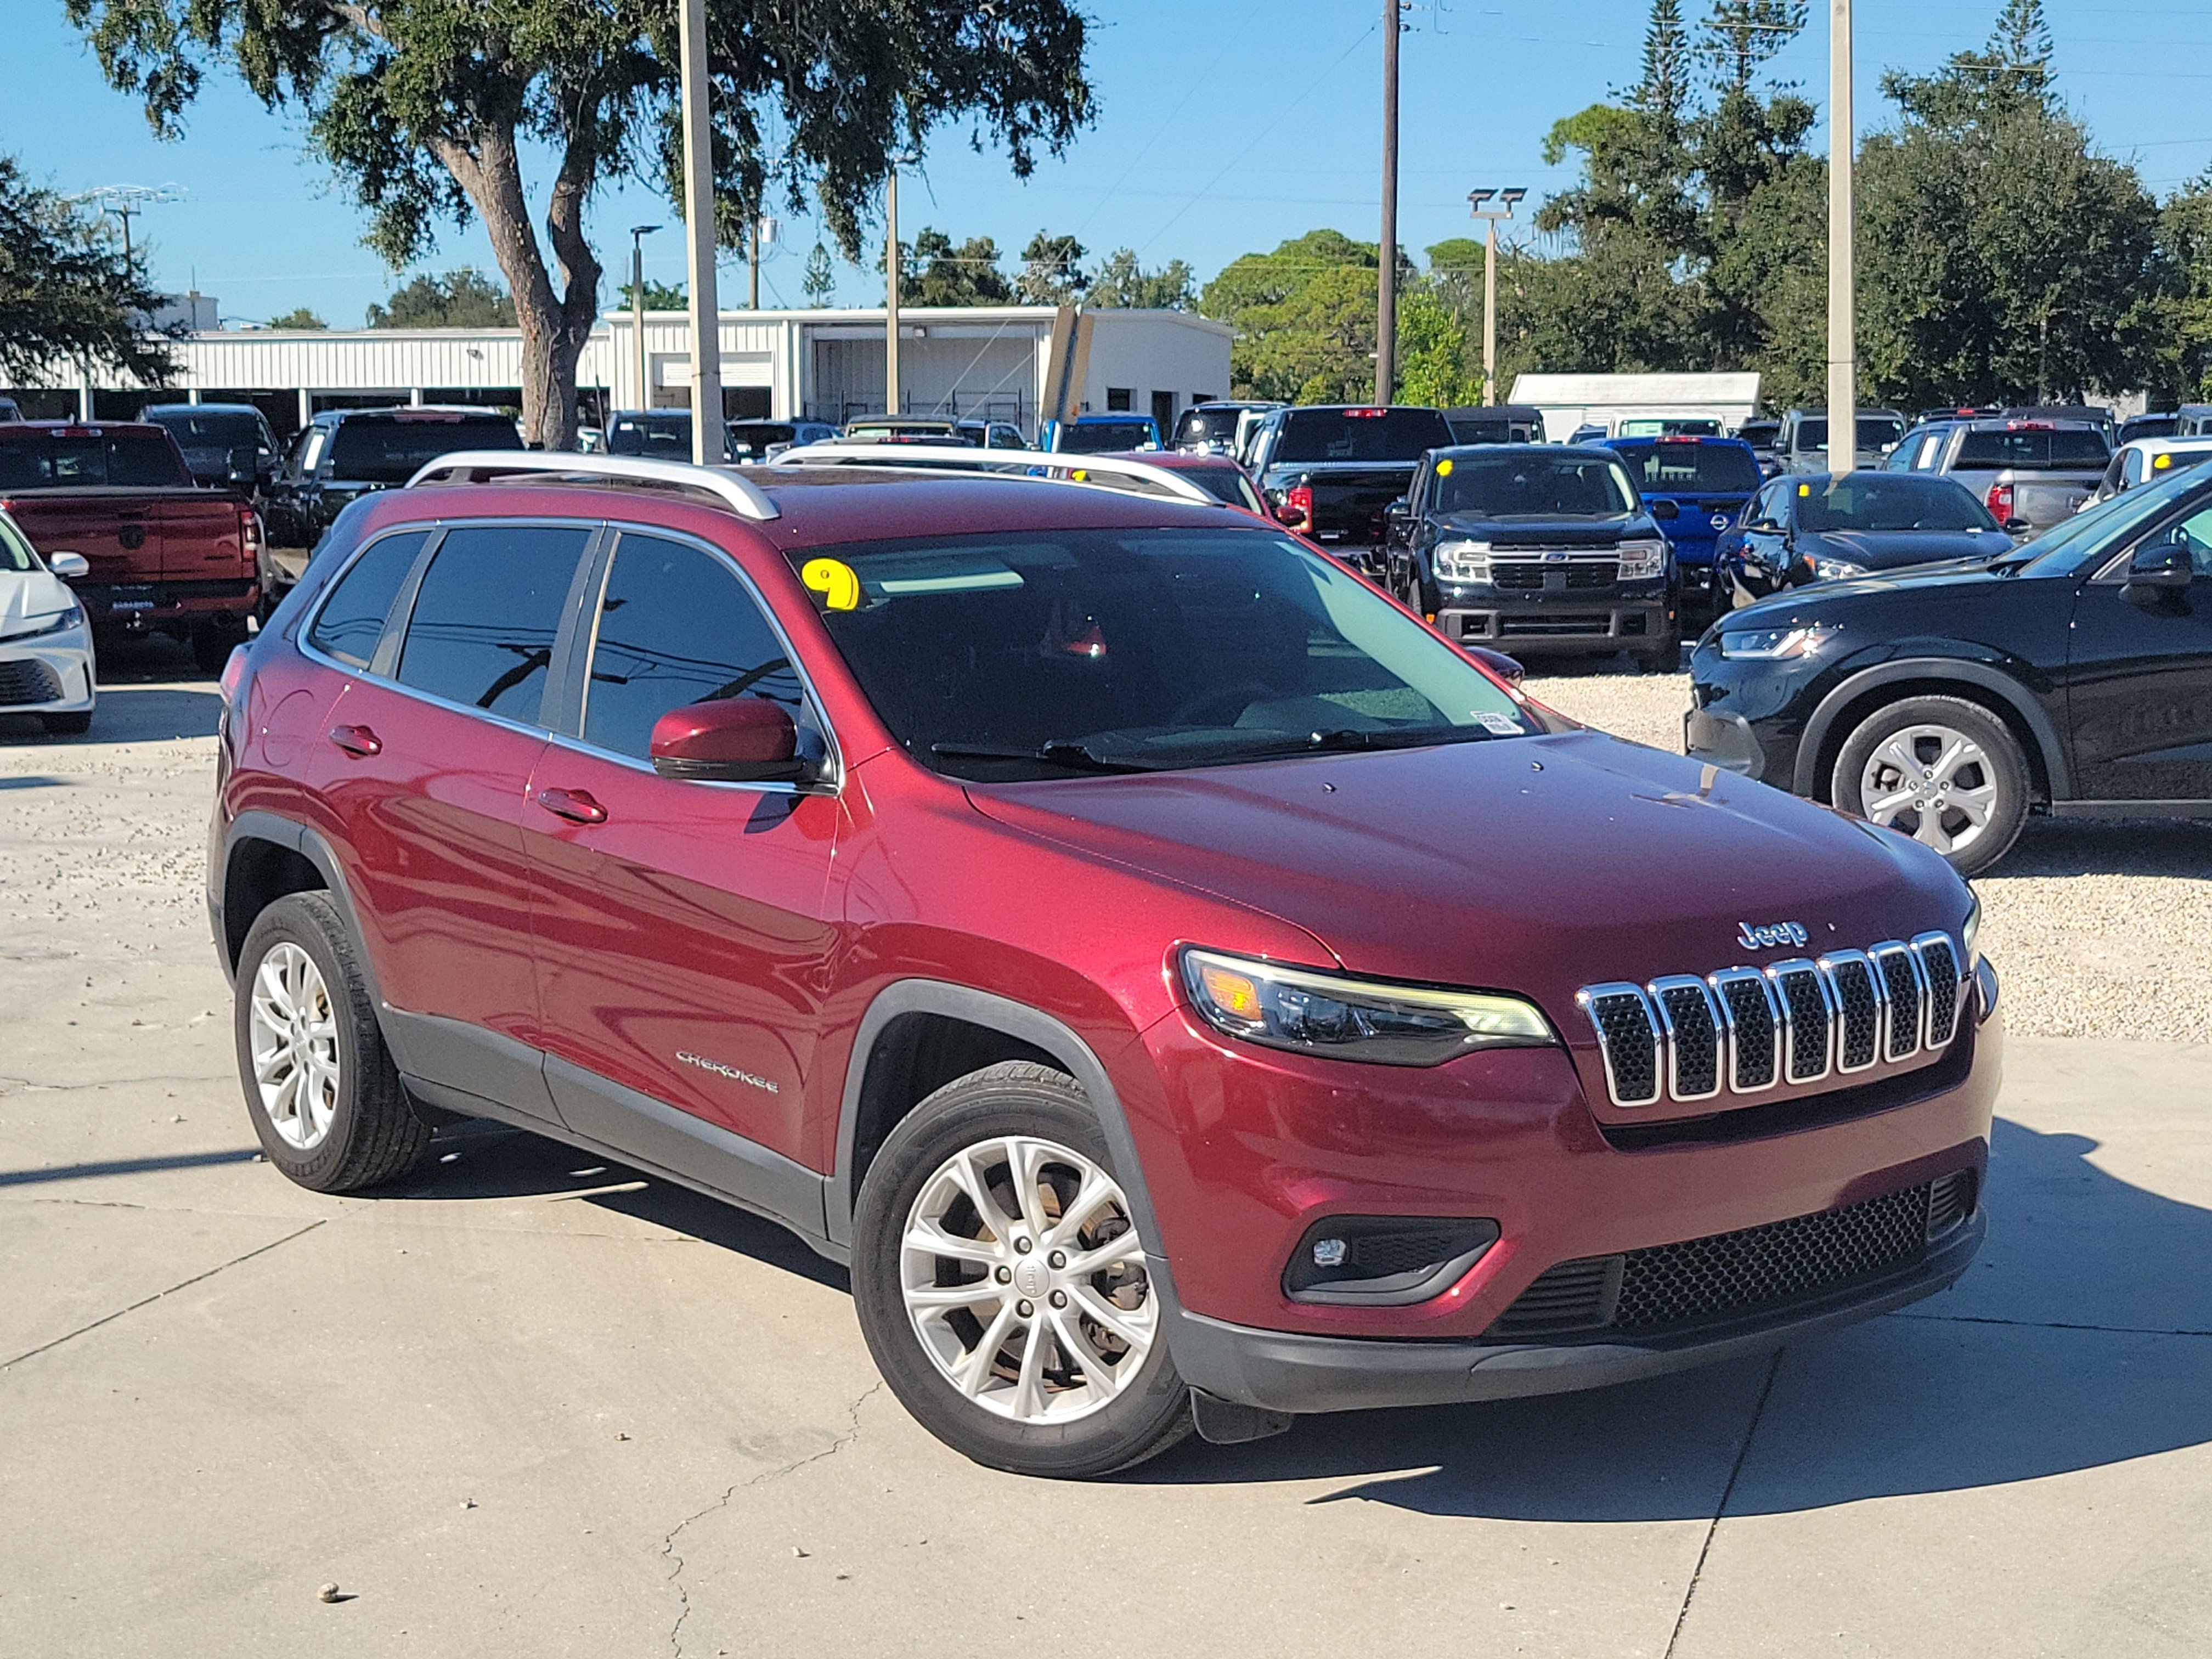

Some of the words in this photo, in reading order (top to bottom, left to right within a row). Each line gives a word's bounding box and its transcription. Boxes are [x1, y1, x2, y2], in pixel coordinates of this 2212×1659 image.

[801, 557, 859, 610] 9
[1737, 922, 1807, 950] Jeep
[675, 1051, 779, 1093] CHEROKEE
